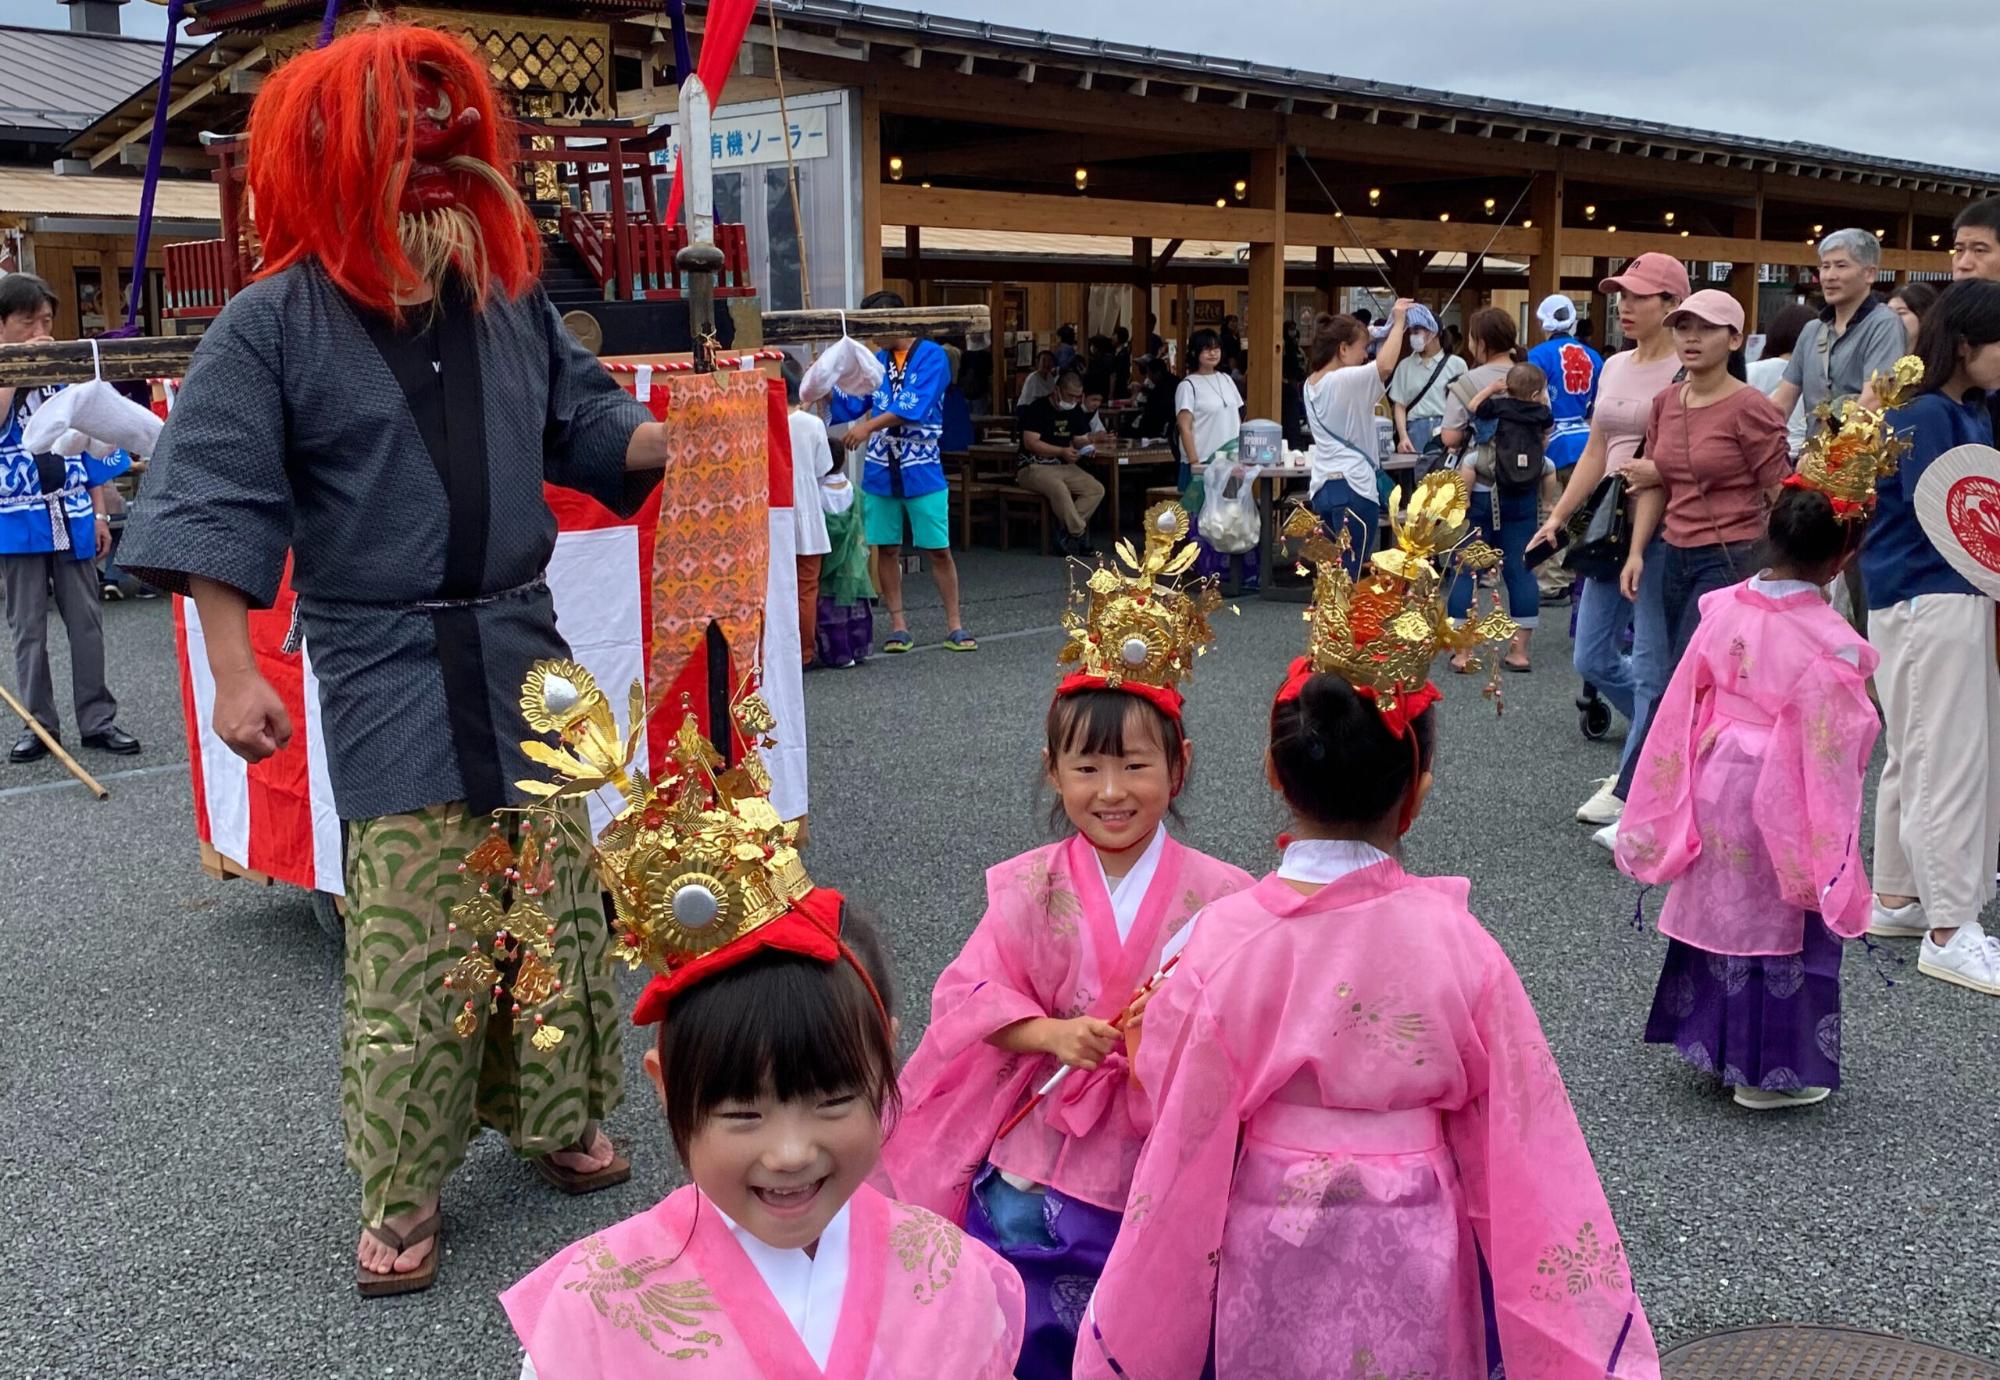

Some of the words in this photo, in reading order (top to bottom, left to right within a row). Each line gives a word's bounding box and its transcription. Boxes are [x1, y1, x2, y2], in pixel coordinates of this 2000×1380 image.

[711, 124, 823, 159] 有機ソーラー
